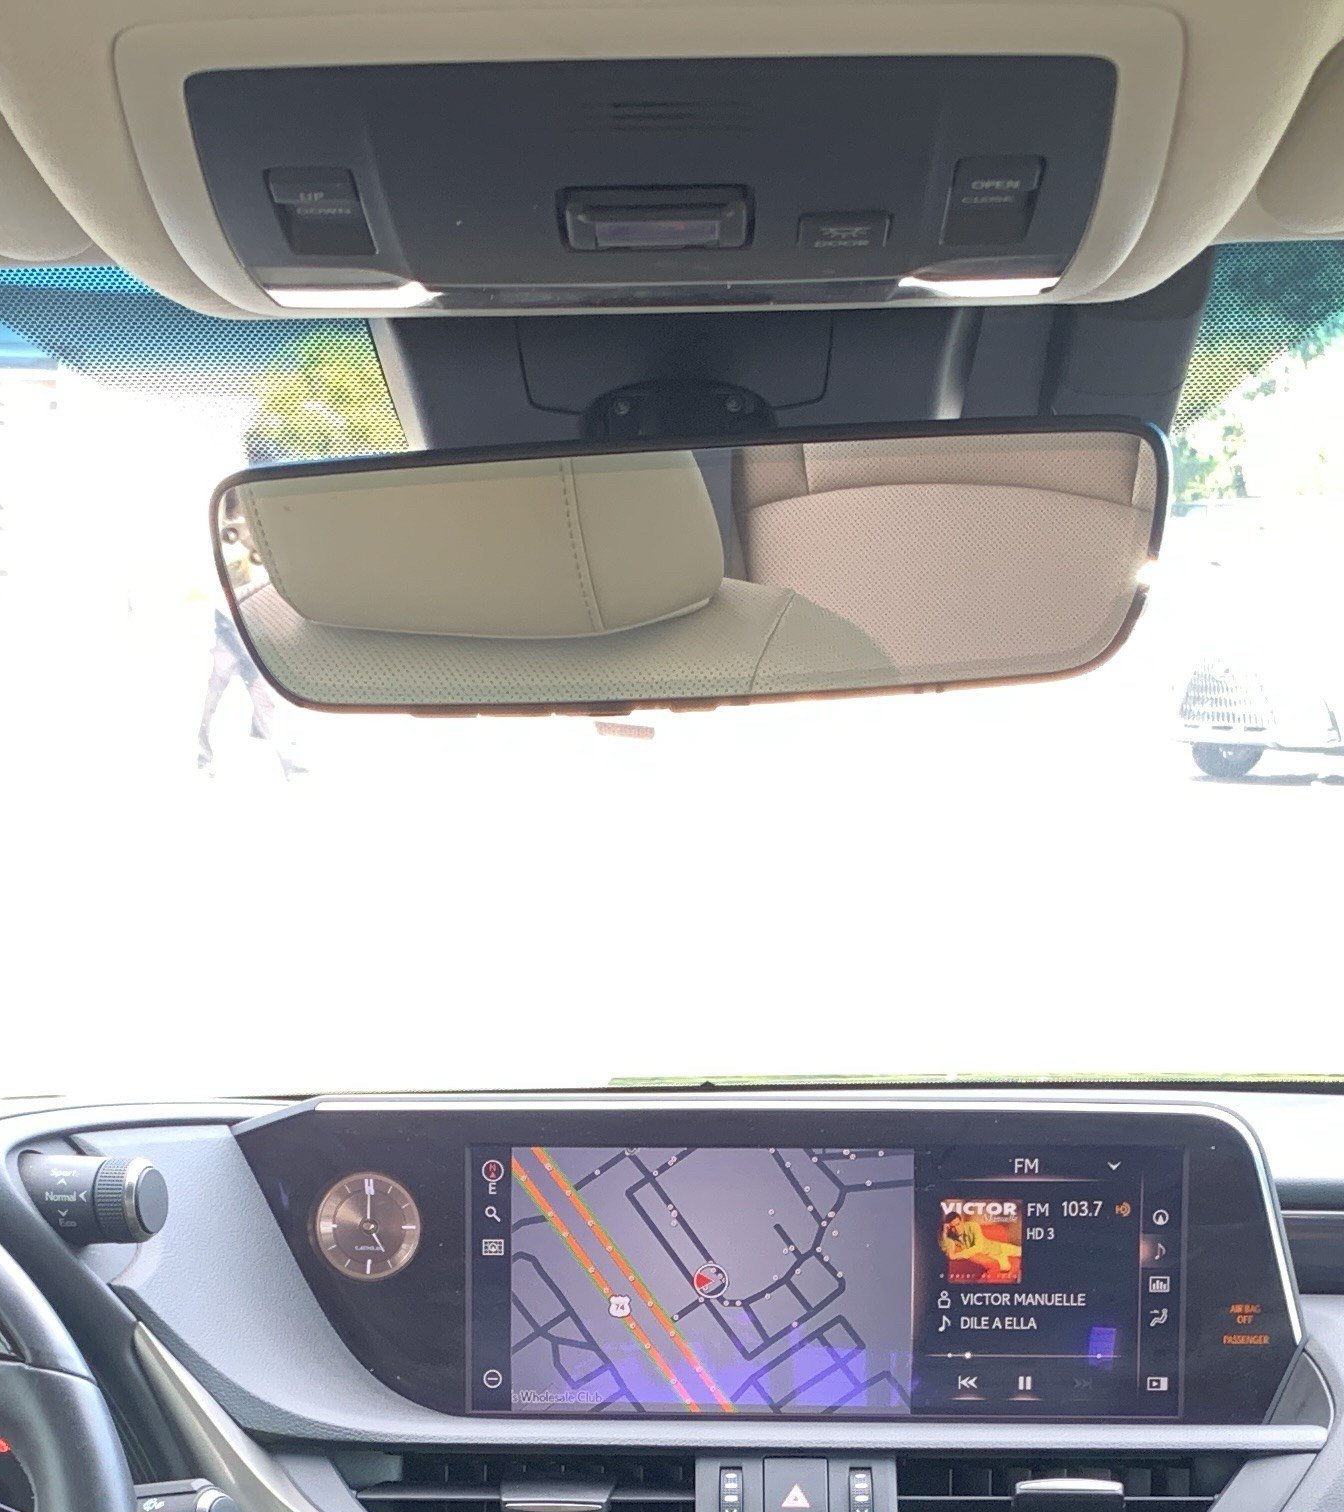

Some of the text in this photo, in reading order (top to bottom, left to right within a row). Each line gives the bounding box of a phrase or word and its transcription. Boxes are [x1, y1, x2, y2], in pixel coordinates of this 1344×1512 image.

[971, 180, 1020, 190] OPEN
[1014, 1158, 1039, 1174] FM
[488, 1182, 497, 1195] E
[45, 1190, 77, 1202] Normal
[940, 1201, 1017, 1216] VICTOR
[1027, 1201, 1103, 1217] FM 103.7
[1026, 1227, 1055, 1241] HD 3
[960, 1293, 1087, 1307] VICTOR MANUELLE
[615, 1303, 625, 1311] 74
[960, 1317, 1038, 1330] DILE A ELLA
[1237, 1315, 1254, 1324] OFF
[1223, 1335, 1271, 1345] PASSENGER
[521, 1390, 574, 1403] Wholesale
[577, 1391, 604, 1403] Club
